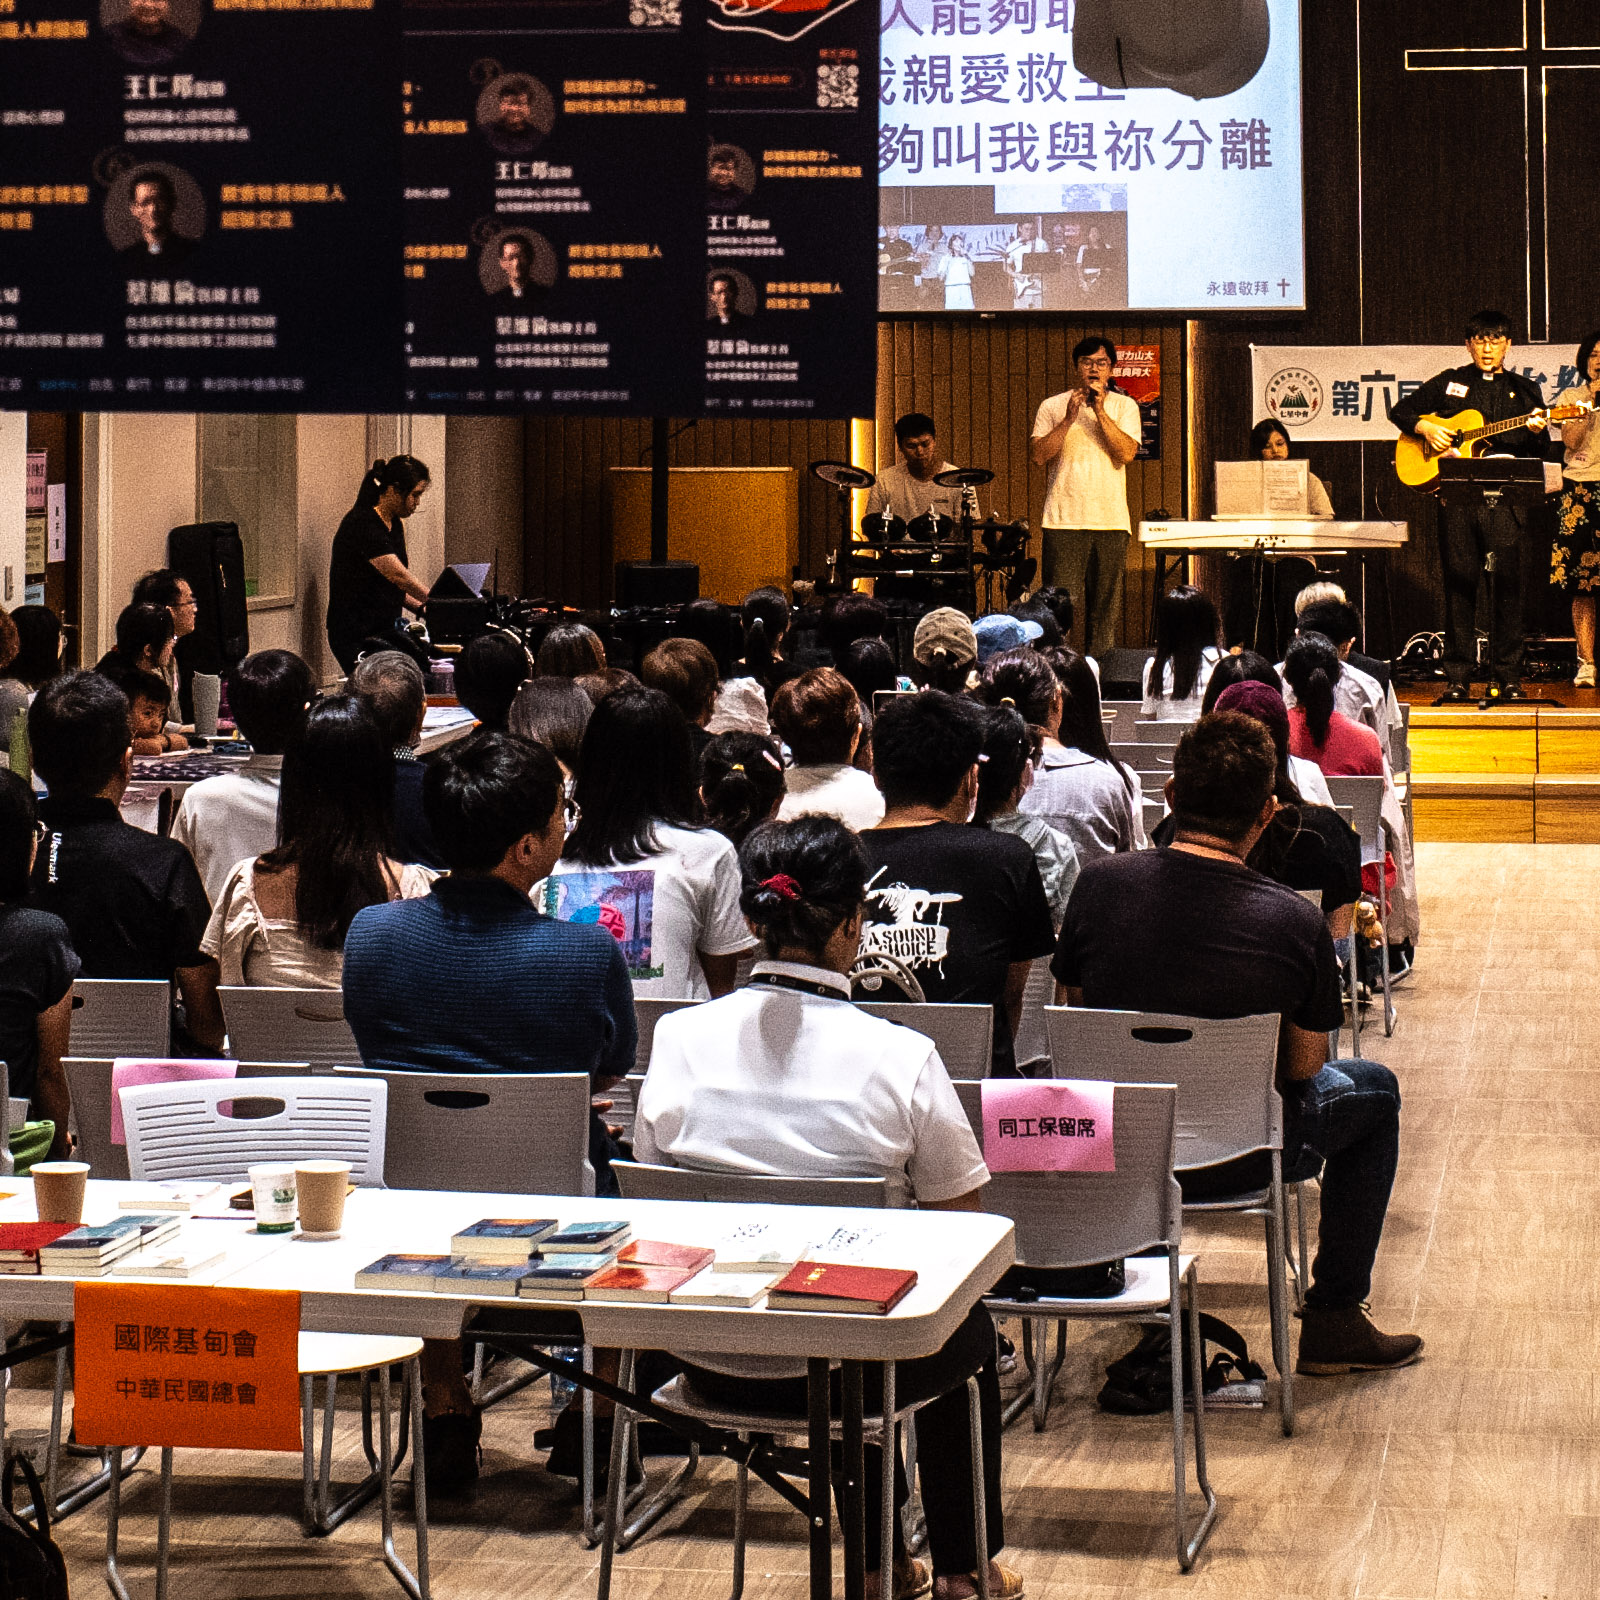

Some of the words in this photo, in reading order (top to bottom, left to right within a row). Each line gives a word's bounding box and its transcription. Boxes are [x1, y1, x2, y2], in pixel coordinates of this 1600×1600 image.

[878, 117, 1273, 175] 夠叫我與祢分離
[869, 932, 880, 946] A
[882, 926, 937, 943] SOUND
[999, 1116, 1096, 1140] 同工保留席
[113, 1322, 259, 1359] 國際基甸會
[114, 1377, 259, 1406] 中華民國總會
